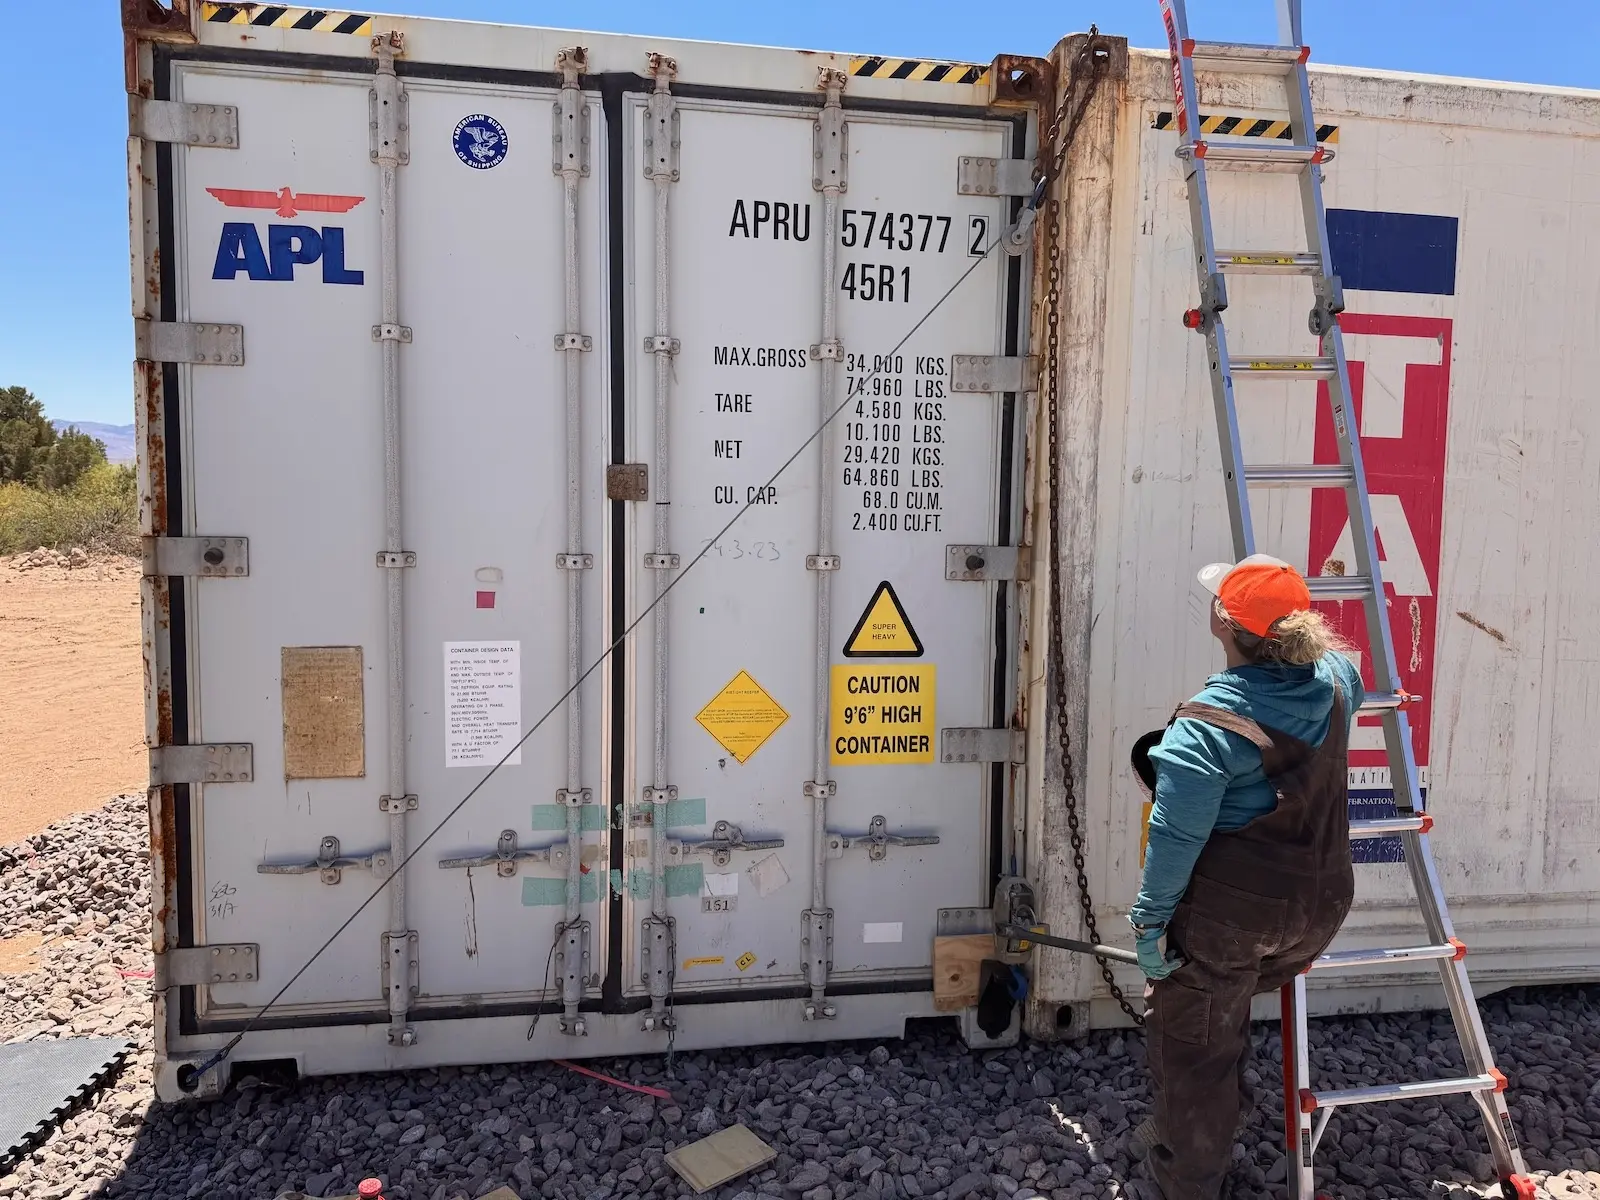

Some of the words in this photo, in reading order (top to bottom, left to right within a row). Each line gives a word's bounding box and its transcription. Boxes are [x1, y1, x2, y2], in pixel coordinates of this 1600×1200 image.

[1172, 63, 1183, 98] MAX
[454, 115, 485, 140] AMERICAN
[488, 118, 508, 146] BUREAU
[458, 151, 468, 161] OF
[468, 155, 502, 168] SHIPPING
[728, 199, 811, 242] APRU
[841, 209, 952, 253] 574377
[970, 217, 987, 255] 2
[212, 222, 364, 286] APL
[840, 262, 911, 303] 45R1
[714, 346, 807, 368] MAX.GROSS
[915, 356, 948, 376] KGS.
[915, 379, 947, 399] LBS.
[715, 393, 753, 413] TARE
[855, 400, 901, 420] 4,580
[914, 402, 946, 421] KGS.
[846, 423, 901, 442] 10,100
[913, 425, 945, 444] LBS.
[714, 440, 743, 459] NET
[843, 445, 900, 465] 29,420
[912, 447, 944, 466] KGS.
[843, 467, 899, 487] 64,860
[911, 469, 944, 488] LBS.
[714, 485, 739, 505] CU.
[747, 486, 778, 505] CAP.
[863, 490, 899, 510] 68.0
[906, 491, 943, 511] CU.M.
[852, 512, 898, 532] 2,400
[904, 513, 942, 532] CU.FT.
[847, 675, 920, 694] CAUTION
[881, 705, 922, 723] HIGH
[835, 735, 930, 755] CONTAINER
[706, 900, 729, 912] 151
